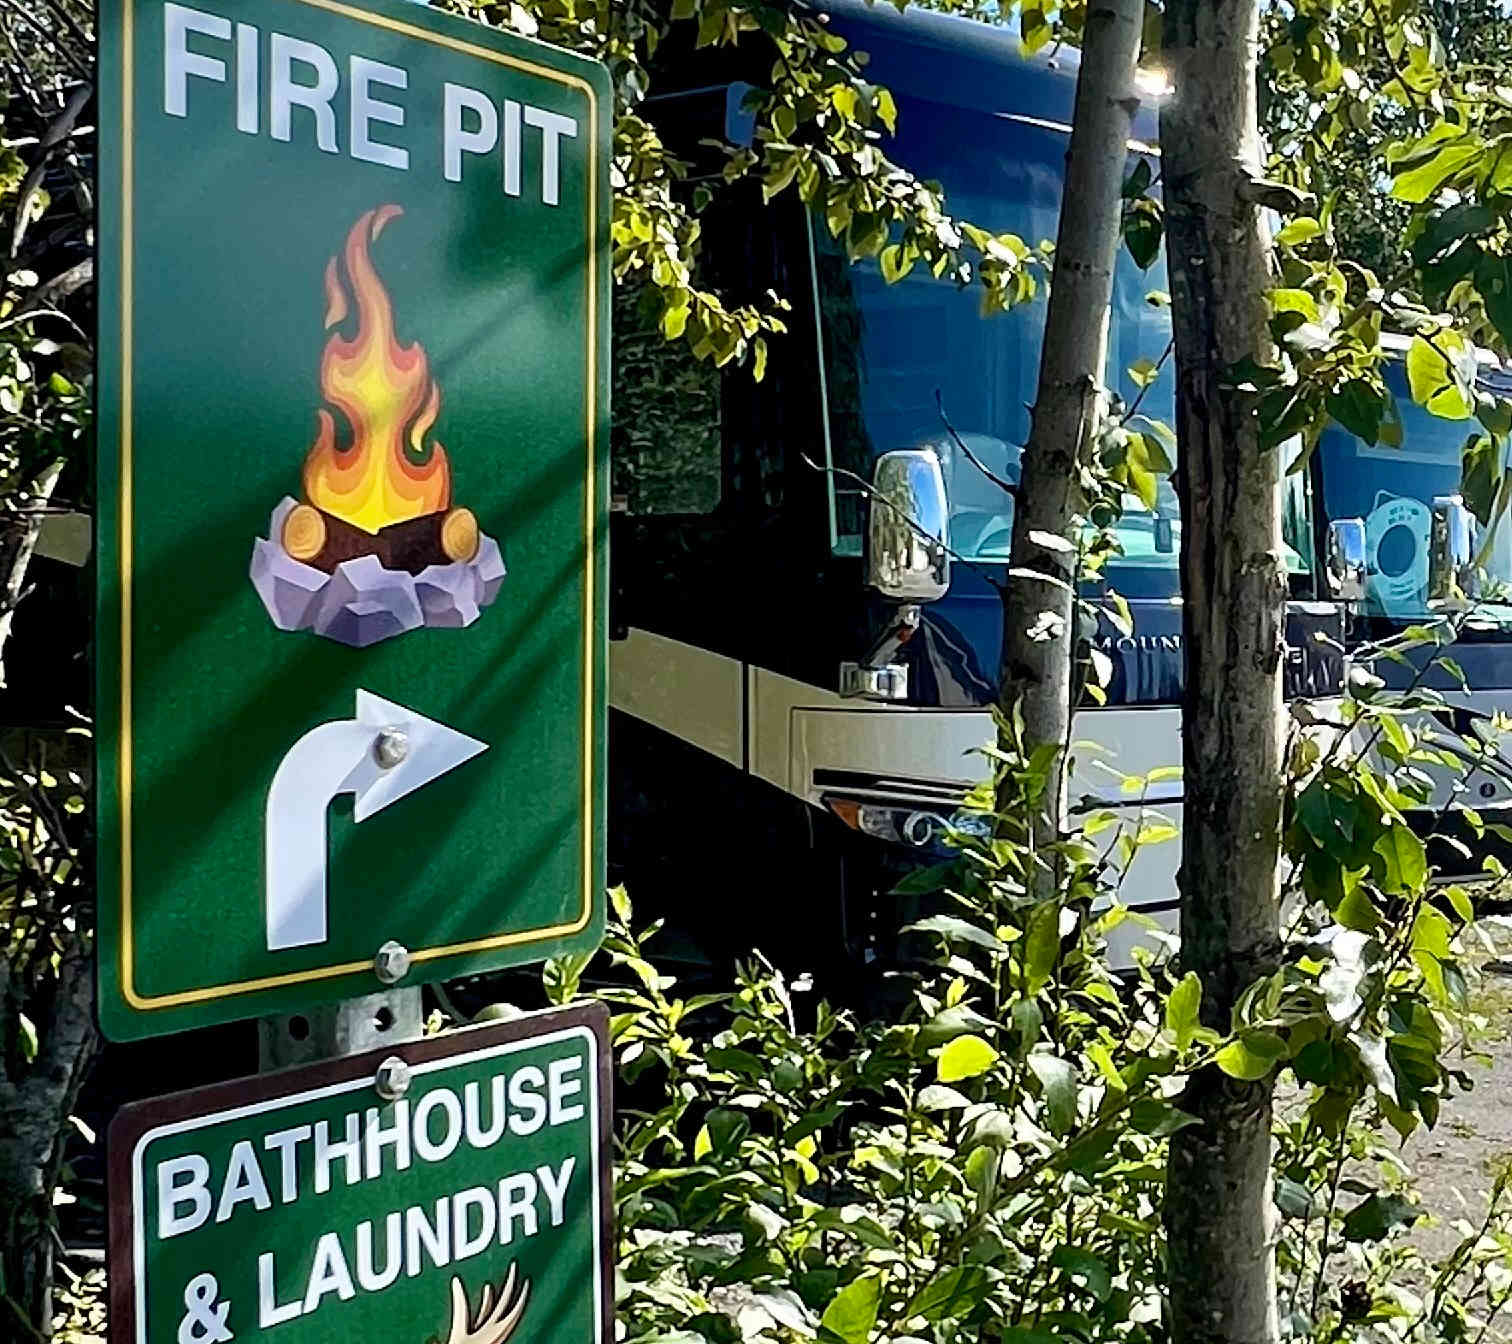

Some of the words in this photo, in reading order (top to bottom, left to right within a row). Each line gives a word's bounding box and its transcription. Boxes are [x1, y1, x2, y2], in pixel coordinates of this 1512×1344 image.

[164, 2, 409, 170] FIRE
[443, 82, 578, 206] PIT
[1090, 635, 1181, 654] MOUN
[157, 1054, 585, 1240] BATHHOUSE
[258, 1156, 578, 1329] LAUNDRY
